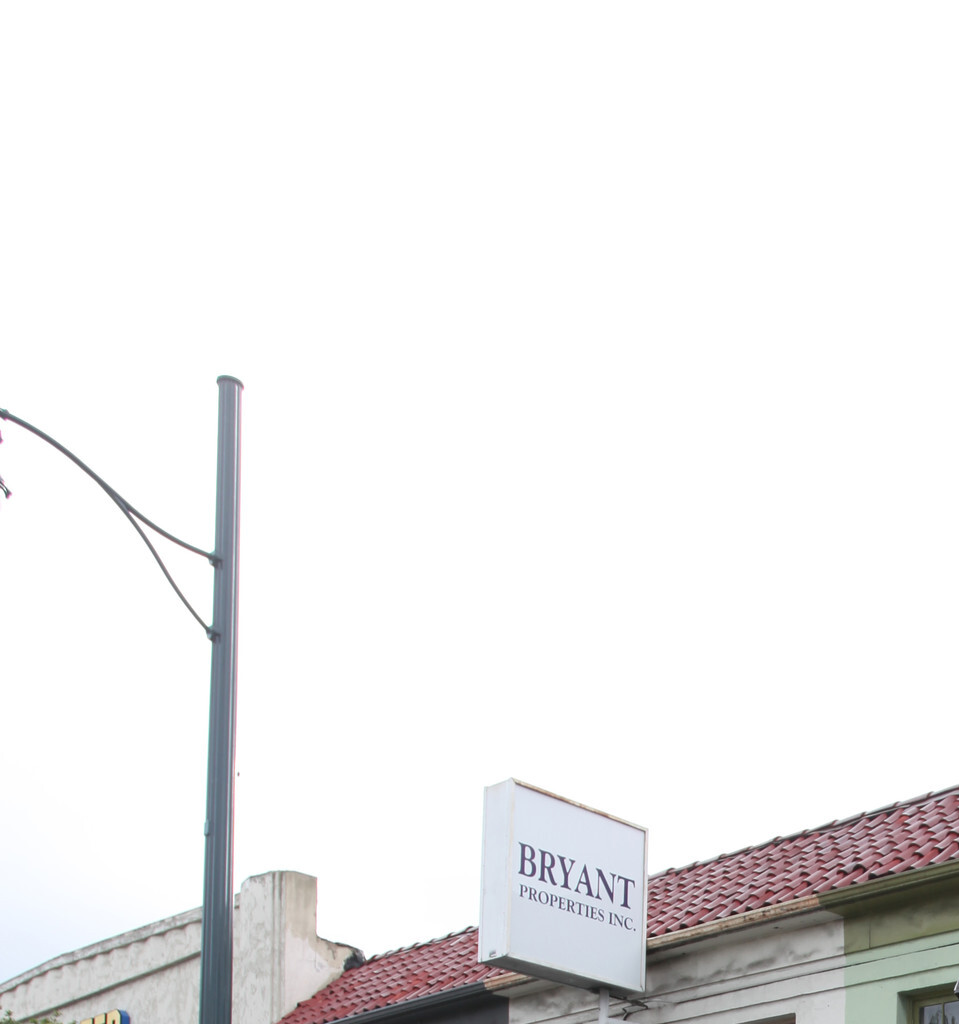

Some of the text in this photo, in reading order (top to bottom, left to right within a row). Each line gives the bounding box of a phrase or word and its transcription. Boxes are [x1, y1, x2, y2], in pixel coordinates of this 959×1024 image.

[518, 841, 636, 910] BRYANT
[519, 883, 637, 932] PROPERTIES INC.
